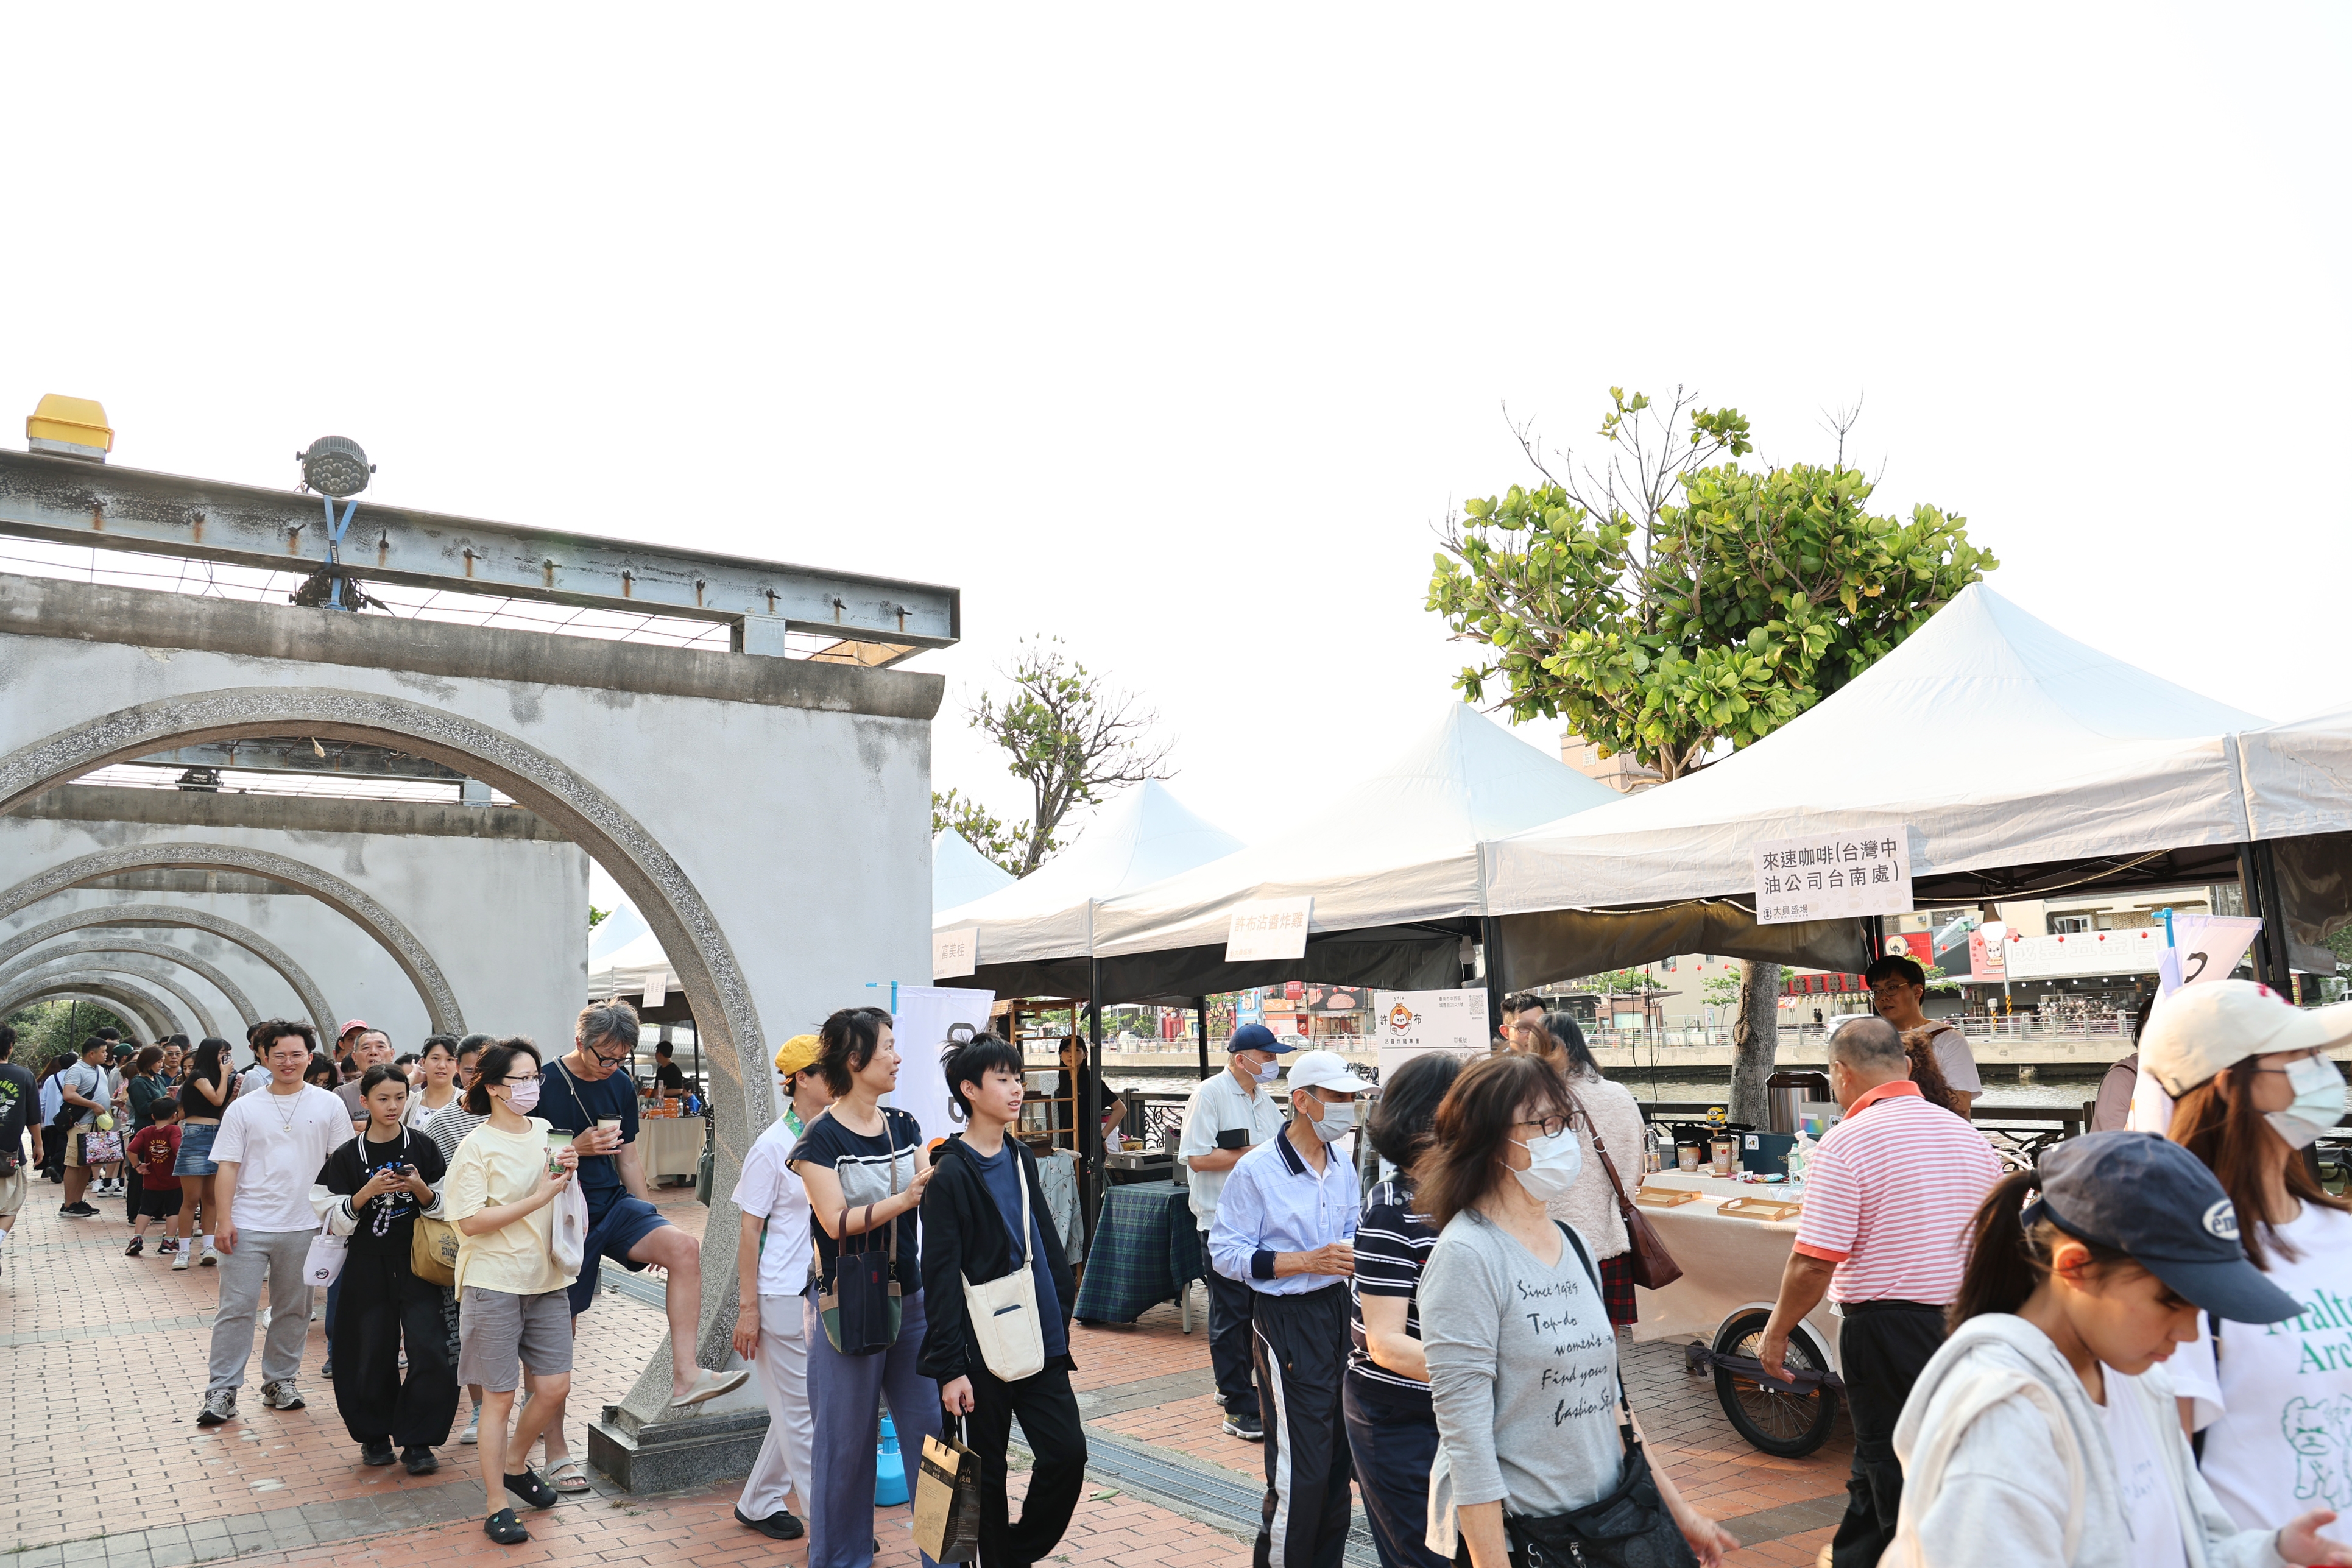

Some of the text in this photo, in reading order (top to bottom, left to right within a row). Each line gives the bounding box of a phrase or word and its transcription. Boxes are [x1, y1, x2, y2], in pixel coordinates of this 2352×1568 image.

[1762, 838, 1898, 871] 來速咖啡(台灣中
[1764, 860, 1900, 895] 油公司台南處)
[1773, 904, 1809, 916] 大員盛場
[1234, 911, 1304, 933] 許布沾醬炸雞
[941, 942, 966, 960] 富美桂
[2011, 931, 2167, 962] 成昱五金百
[2012, 963, 2050, 975] 安平店
[1380, 1013, 1422, 1026] 許 布
[0, 1079, 19, 1094] ARY
[442, 1246, 457, 1259] SNOO
[1517, 1279, 1578, 1300] Since 1989
[1527, 1311, 1579, 1335] Top-do
[2297, 1332, 2352, 1374] Arc
[1541, 1364, 1608, 1390] Find your
